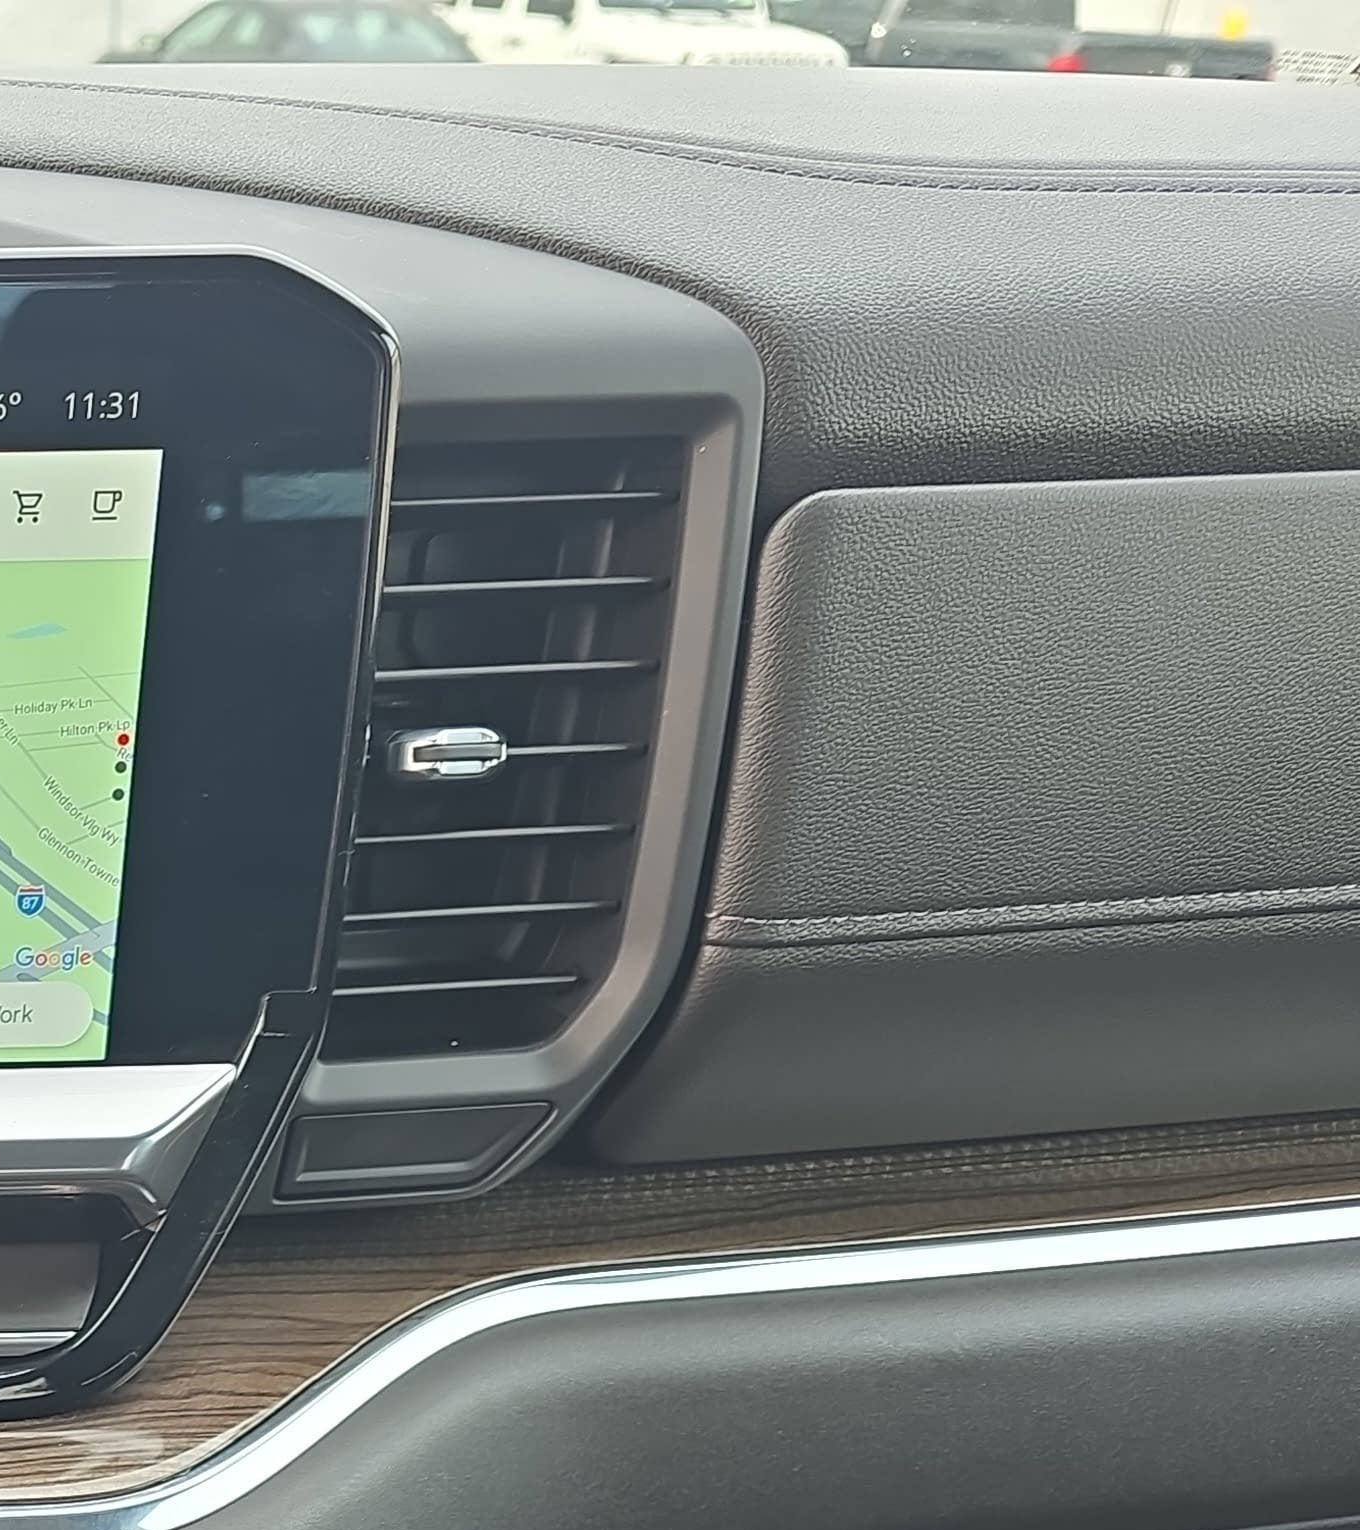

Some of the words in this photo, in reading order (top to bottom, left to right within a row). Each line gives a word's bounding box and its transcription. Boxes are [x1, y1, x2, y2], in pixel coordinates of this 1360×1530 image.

[63, 391, 142, 422] 11:31
[13, 701, 58, 716] Holiday
[78, 698, 94, 709] Ln
[60, 723, 95, 738] Hilton
[43, 775, 83, 821] Windsor
[37, 826, 83, 865] Glennon
[81, 856, 121, 888] Towne
[15, 945, 93, 971] Google
